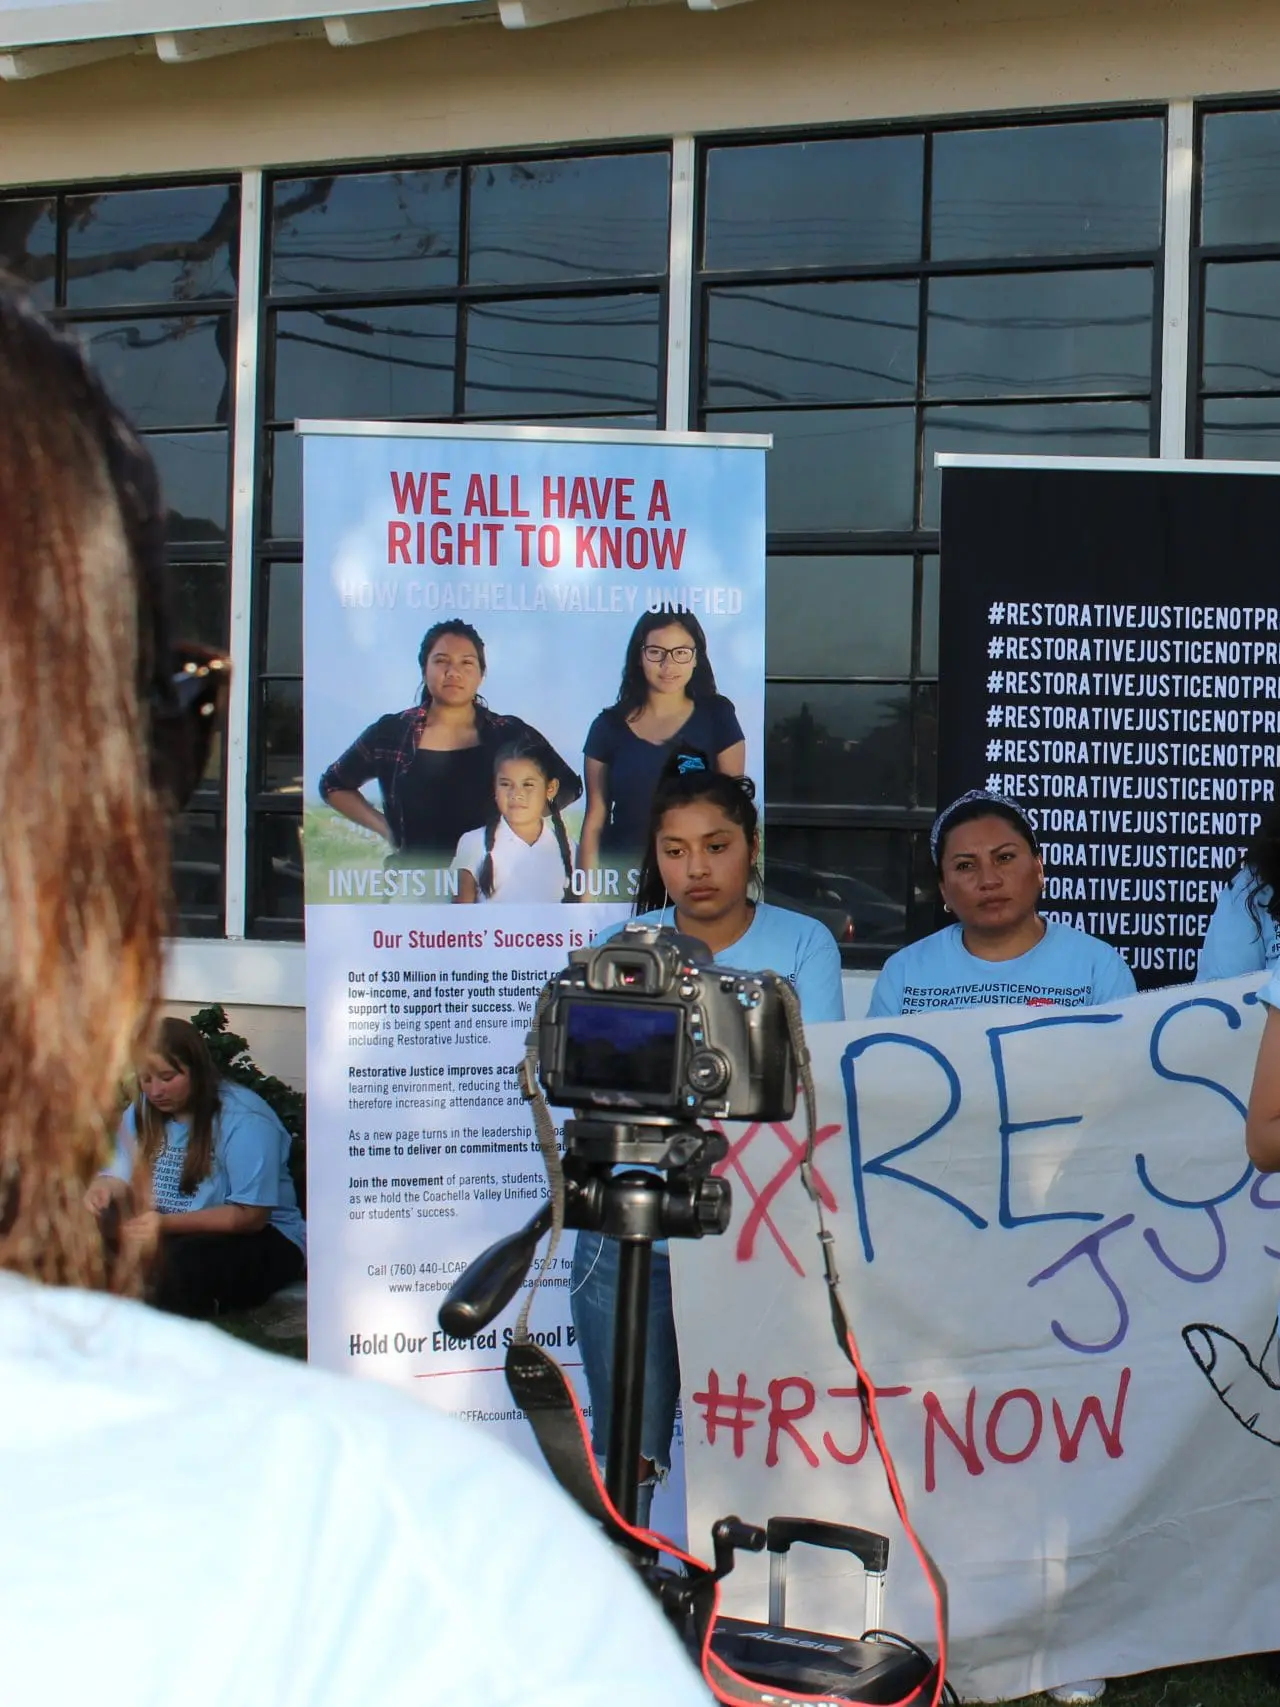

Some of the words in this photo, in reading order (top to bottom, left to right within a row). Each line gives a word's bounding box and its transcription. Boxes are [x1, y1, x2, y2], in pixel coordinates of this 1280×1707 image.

[391, 471, 451, 515] WE
[464, 474, 529, 517] ALL
[543, 476, 635, 520] HAVE
[648, 480, 671, 521] A
[388, 521, 503, 566] RIGHT
[515, 524, 560, 568] TO
[576, 527, 686, 570] KNOW
[341, 581, 399, 608] HOW
[407, 582, 546, 612] COACHELLA
[552, 585, 637, 612] VALLEY
[647, 587, 742, 615] UNIFIED
[985, 739, 1280, 768] #RESTORATIVEJUSTICENOTPRI
[985, 773, 1274, 802] #RESTORATIVEJUSTICENOTPR
[329, 869, 425, 897] INVESTS
[434, 868, 459, 896] IN
[571, 869, 618, 896] OUR
[373, 931, 400, 948] Our
[408, 930, 487, 948] Students'
[494, 929, 563, 947] Success
[570, 930, 583, 946] is
[349, 972, 365, 982] Out
[369, 971, 378, 982] of
[382, 971, 399, 983] $30
[403, 970, 436, 982] Million
[440, 970, 448, 981] in
[452, 970, 488, 984] funding
[492, 970, 507, 981] the
[512, 969, 548, 980] District
[349, 987, 410, 999] low-income,
[413, 987, 432, 998] and
[435, 986, 464, 997] foster
[468, 986, 495, 1000] youth
[349, 1004, 387, 1016] support
[390, 1004, 400, 1014] to
[403, 1003, 442, 1016] support
[445, 1002, 468, 1013] their
[472, 1002, 514, 1013] success.
[518, 1001, 531, 1012] We
[349, 1021, 379, 1032] money
[383, 1019, 391, 1030] is
[395, 1018, 420, 1031] being
[424, 1018, 451, 1030] spent
[455, 1018, 472, 1029] and
[476, 1018, 507, 1029] ensure
[349, 1035, 394, 1048] including
[398, 1033, 452, 1046] Restorative
[455, 1032, 491, 1044] Justice.
[349, 1067, 406, 1077] Restorative
[410, 1066, 444, 1077] Justice
[448, 1065, 493, 1078] improves
[349, 1083, 389, 1095] learning
[459, 1081, 500, 1093] reducing
[504, 1080, 518, 1090] the
[349, 1099, 392, 1109] therefore
[396, 1097, 446, 1109] increasing
[450, 1096, 503, 1107] attendance
[349, 1130, 360, 1140] As
[364, 1131, 369, 1140] a
[374, 1131, 392, 1140] new
[396, 1131, 419, 1142] page
[422, 1129, 447, 1139] turns
[451, 1128, 459, 1138] in
[463, 1127, 479, 1137] the
[482, 1126, 531, 1140] leadership
[349, 1146, 365, 1156] the
[369, 1145, 391, 1156] time
[394, 1145, 404, 1155] to
[407, 1144, 441, 1155] deliver
[445, 1144, 457, 1154] on
[461, 1142, 528, 1154] commitments
[349, 1177, 368, 1188] Join
[372, 1176, 387, 1187] the
[392, 1175, 443, 1187] movement
[447, 1174, 456, 1185] of
[459, 1174, 499, 1190] parents,
[502, 1172, 546, 1185] students,
[350, 1194, 361, 1203] as
[364, 1194, 377, 1203] we
[381, 1191, 400, 1203] hold
[404, 1190, 419, 1202] the
[423, 1189, 470, 1201] Coachella
[473, 1188, 501, 1202] Valley
[505, 1187, 537, 1199] Unified
[350, 1210, 364, 1219] our
[417, 1208, 458, 1217] success.
[368, 1264, 386, 1276] Call
[390, 1263, 416, 1276] (760)
[350, 1333, 387, 1356] Hold
[394, 1332, 427, 1354] Our
